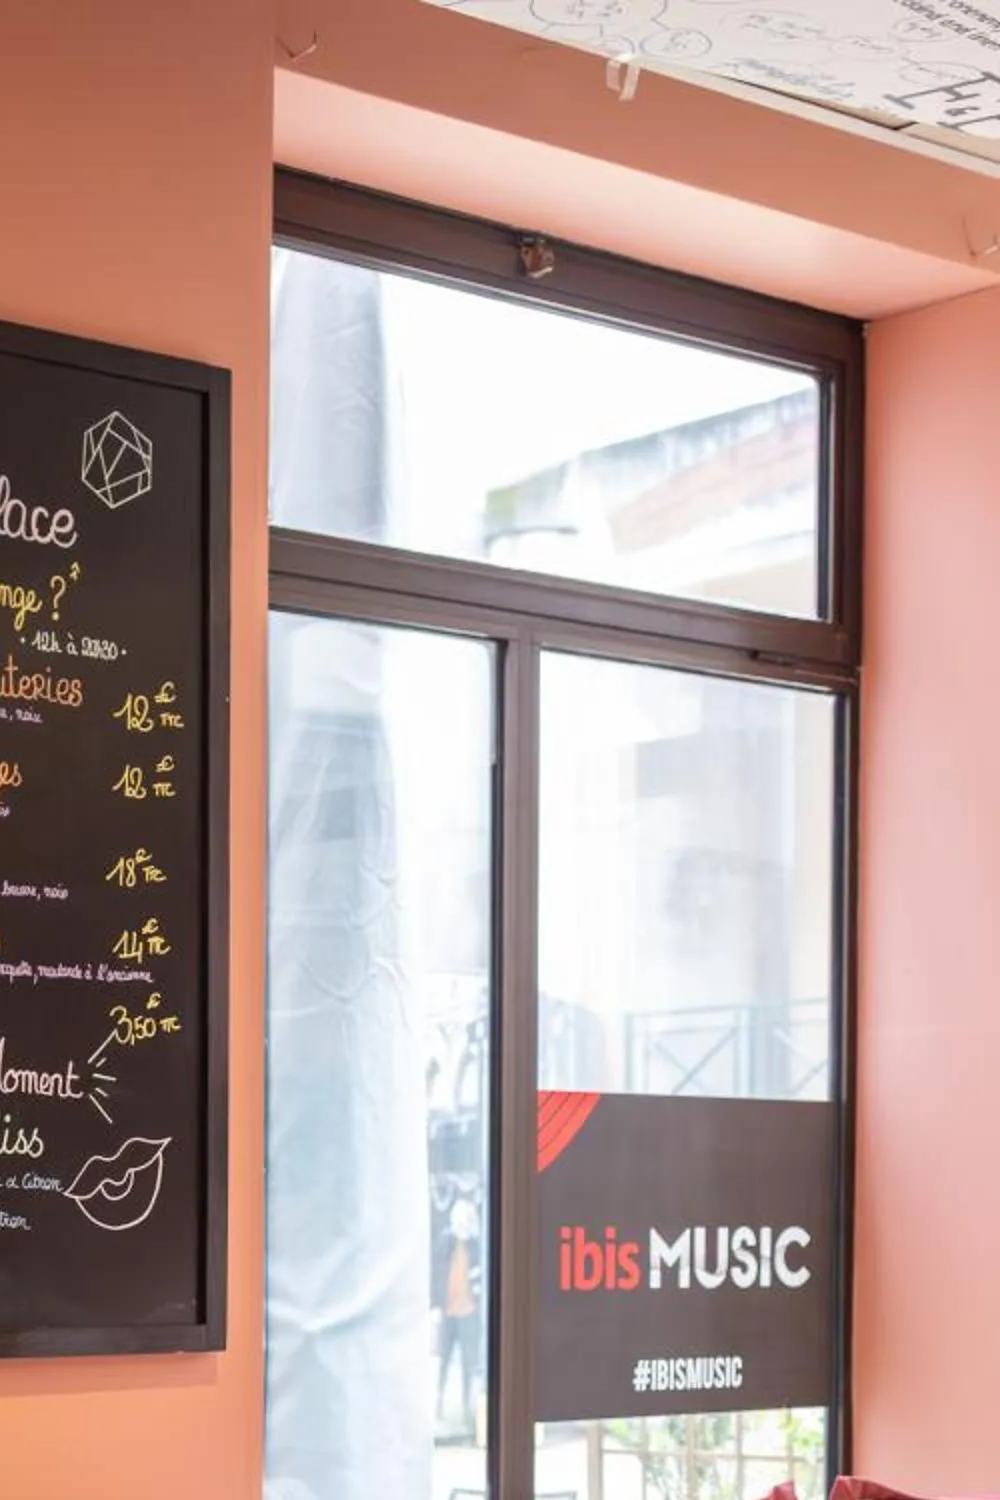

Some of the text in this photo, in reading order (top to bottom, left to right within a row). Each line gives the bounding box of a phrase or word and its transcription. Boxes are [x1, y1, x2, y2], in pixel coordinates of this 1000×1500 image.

[31, 630, 62, 654] 12h
[66, 631, 79, 656] à
[160, 711, 185, 728] TTC
[153, 782, 176, 797] TTC
[160, 1016, 182, 1033] TTC
[559, 1225, 812, 1291] ibis MUSIC
[632, 1356, 744, 1392] #IBISMUSIC
